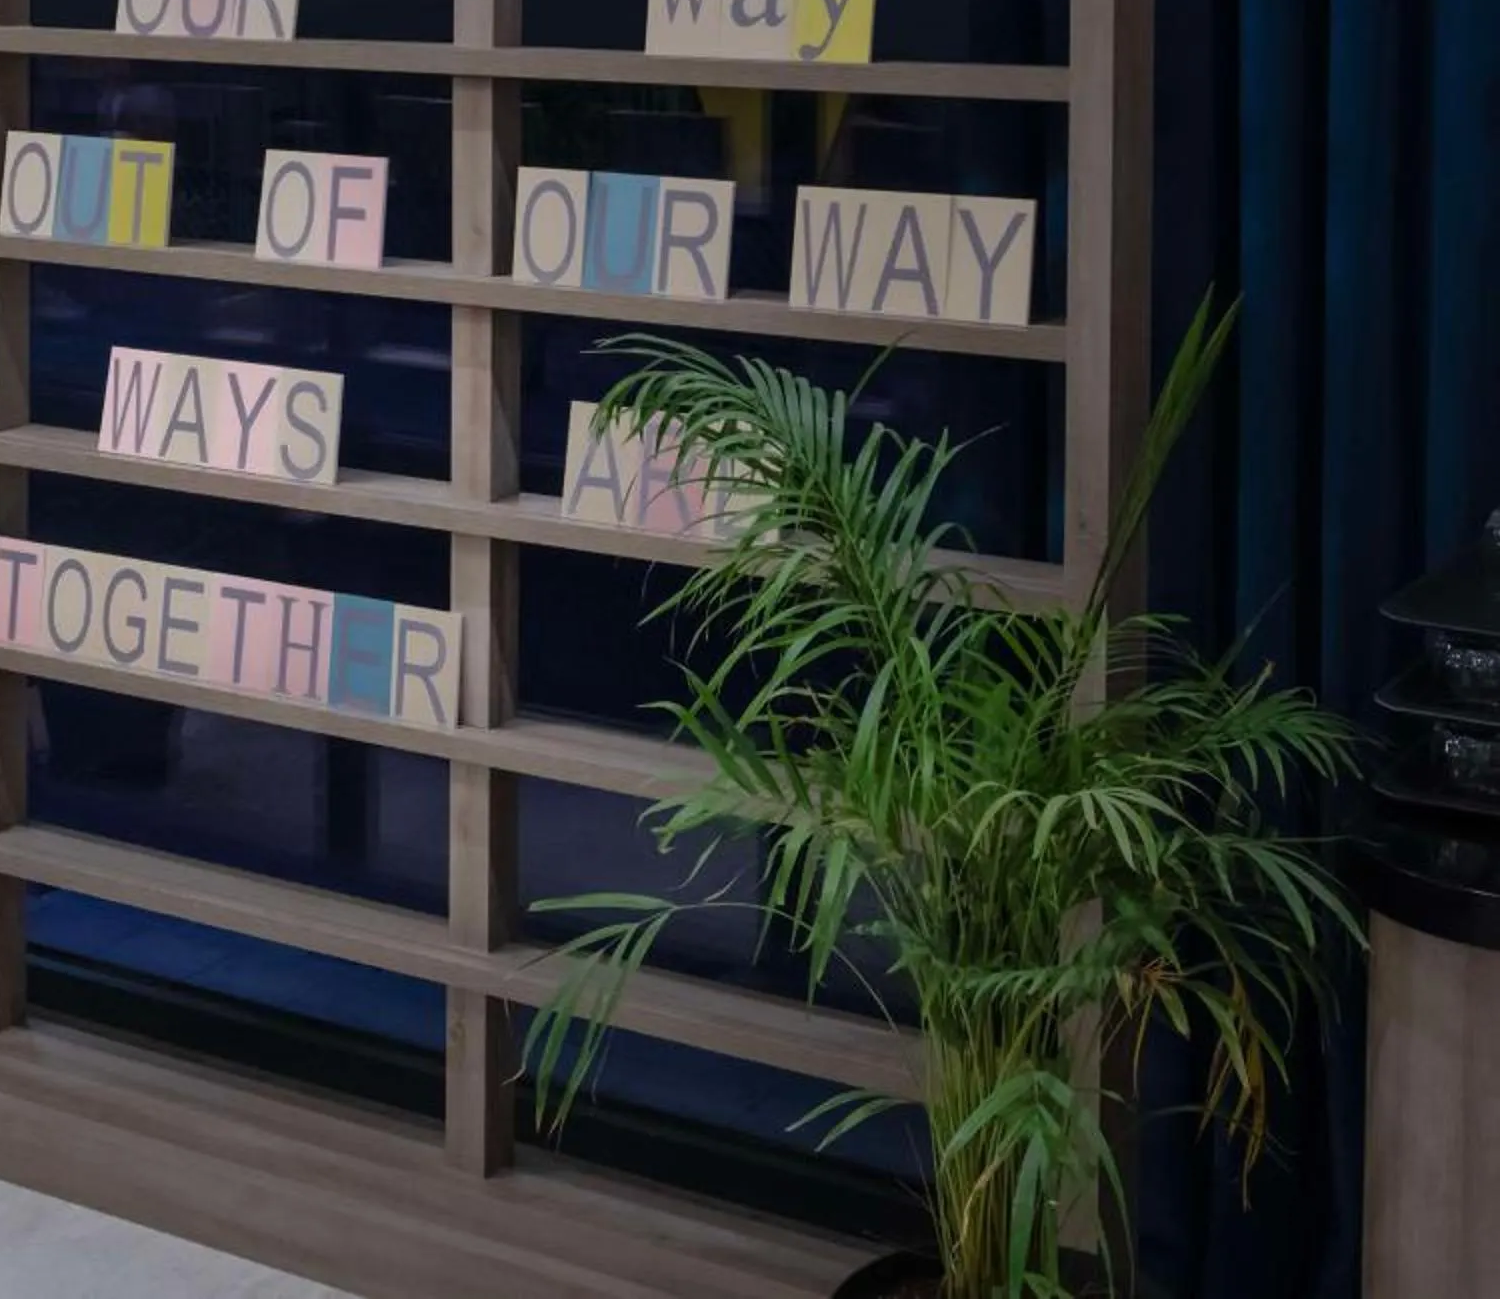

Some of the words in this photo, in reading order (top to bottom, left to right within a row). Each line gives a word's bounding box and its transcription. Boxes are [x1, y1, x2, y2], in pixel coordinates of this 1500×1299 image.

[7, 142, 164, 246] OUT
[267, 160, 373, 261] OF
[521, 179, 719, 296] OUR
[802, 198, 1027, 320] WAY
[110, 361, 328, 481] WAYS
